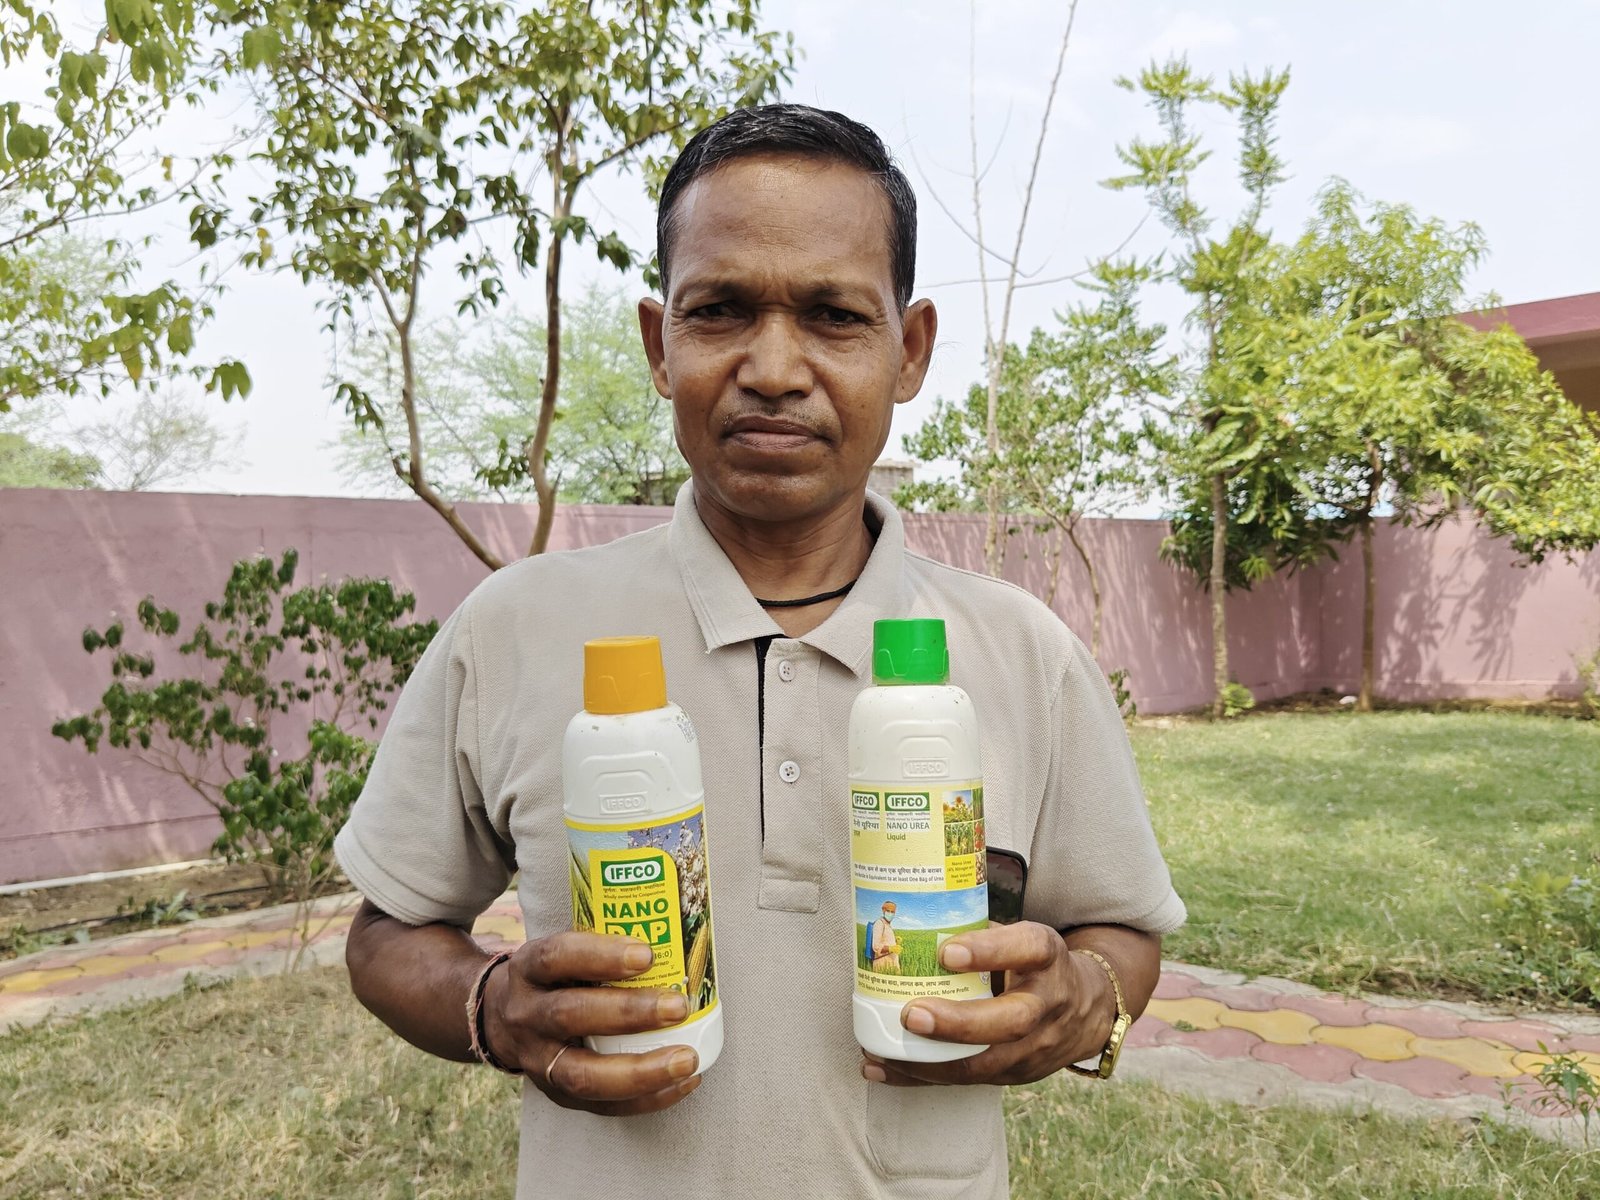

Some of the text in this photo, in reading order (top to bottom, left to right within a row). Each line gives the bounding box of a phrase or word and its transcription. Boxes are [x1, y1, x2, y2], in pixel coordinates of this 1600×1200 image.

[908, 762, 942, 774] IFFCO
[605, 799, 641, 809] IFFCO
[854, 795, 874, 806] IFFCO
[891, 797, 923, 807] IFFCO
[862, 821, 879, 830] यूरिया
[887, 822, 930, 830] NANO UREA
[886, 833, 906, 841] Liquid
[610, 864, 655, 880] IFFCO
[602, 897, 669, 919] NANO
[654, 949, 673, 960] 16:0)
[887, 988, 912, 996] Promises,
[941, 988, 956, 996] More
[956, 986, 970, 994] Profit
